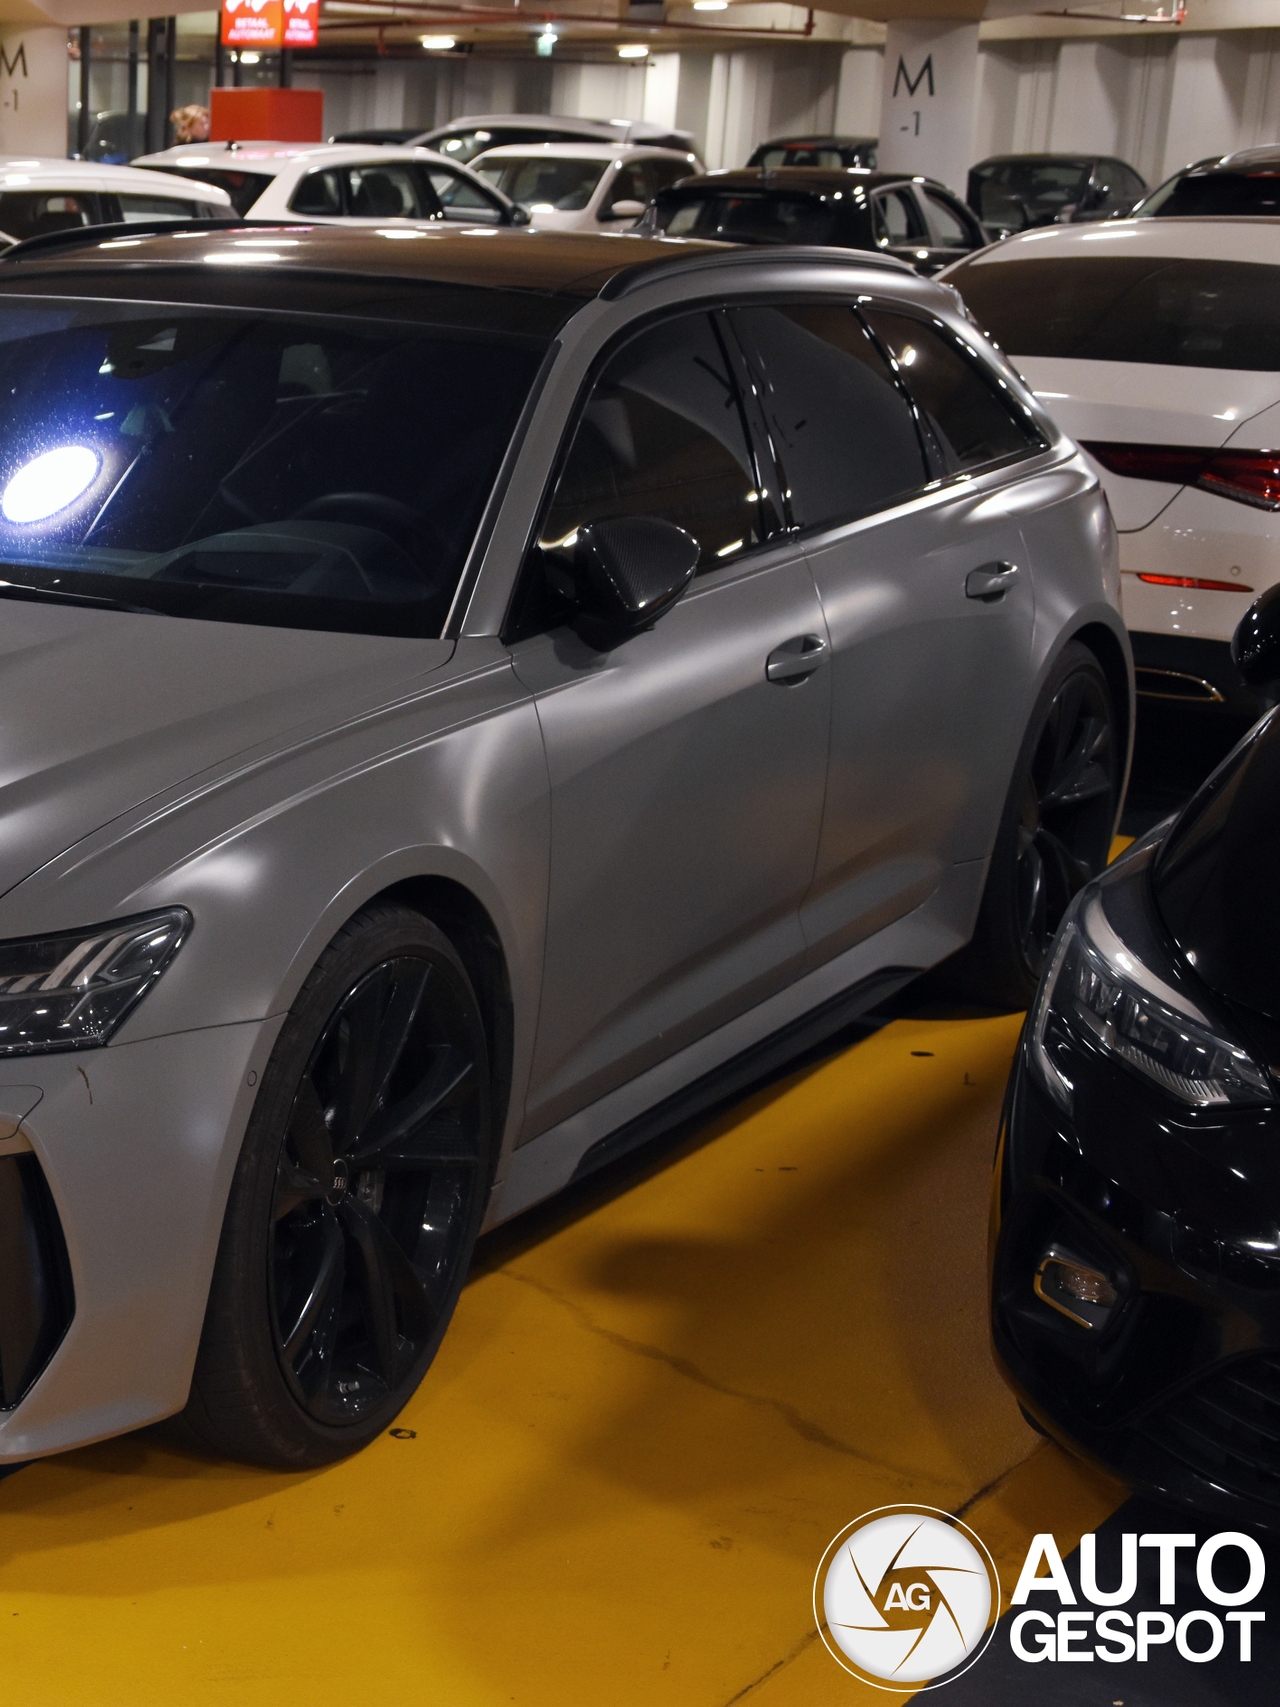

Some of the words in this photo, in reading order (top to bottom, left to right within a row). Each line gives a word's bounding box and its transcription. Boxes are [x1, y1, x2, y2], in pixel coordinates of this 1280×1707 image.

[892, 53, 935, 98] M
[3, 88, 18, 112] -1
[900, 111, 920, 136] -1
